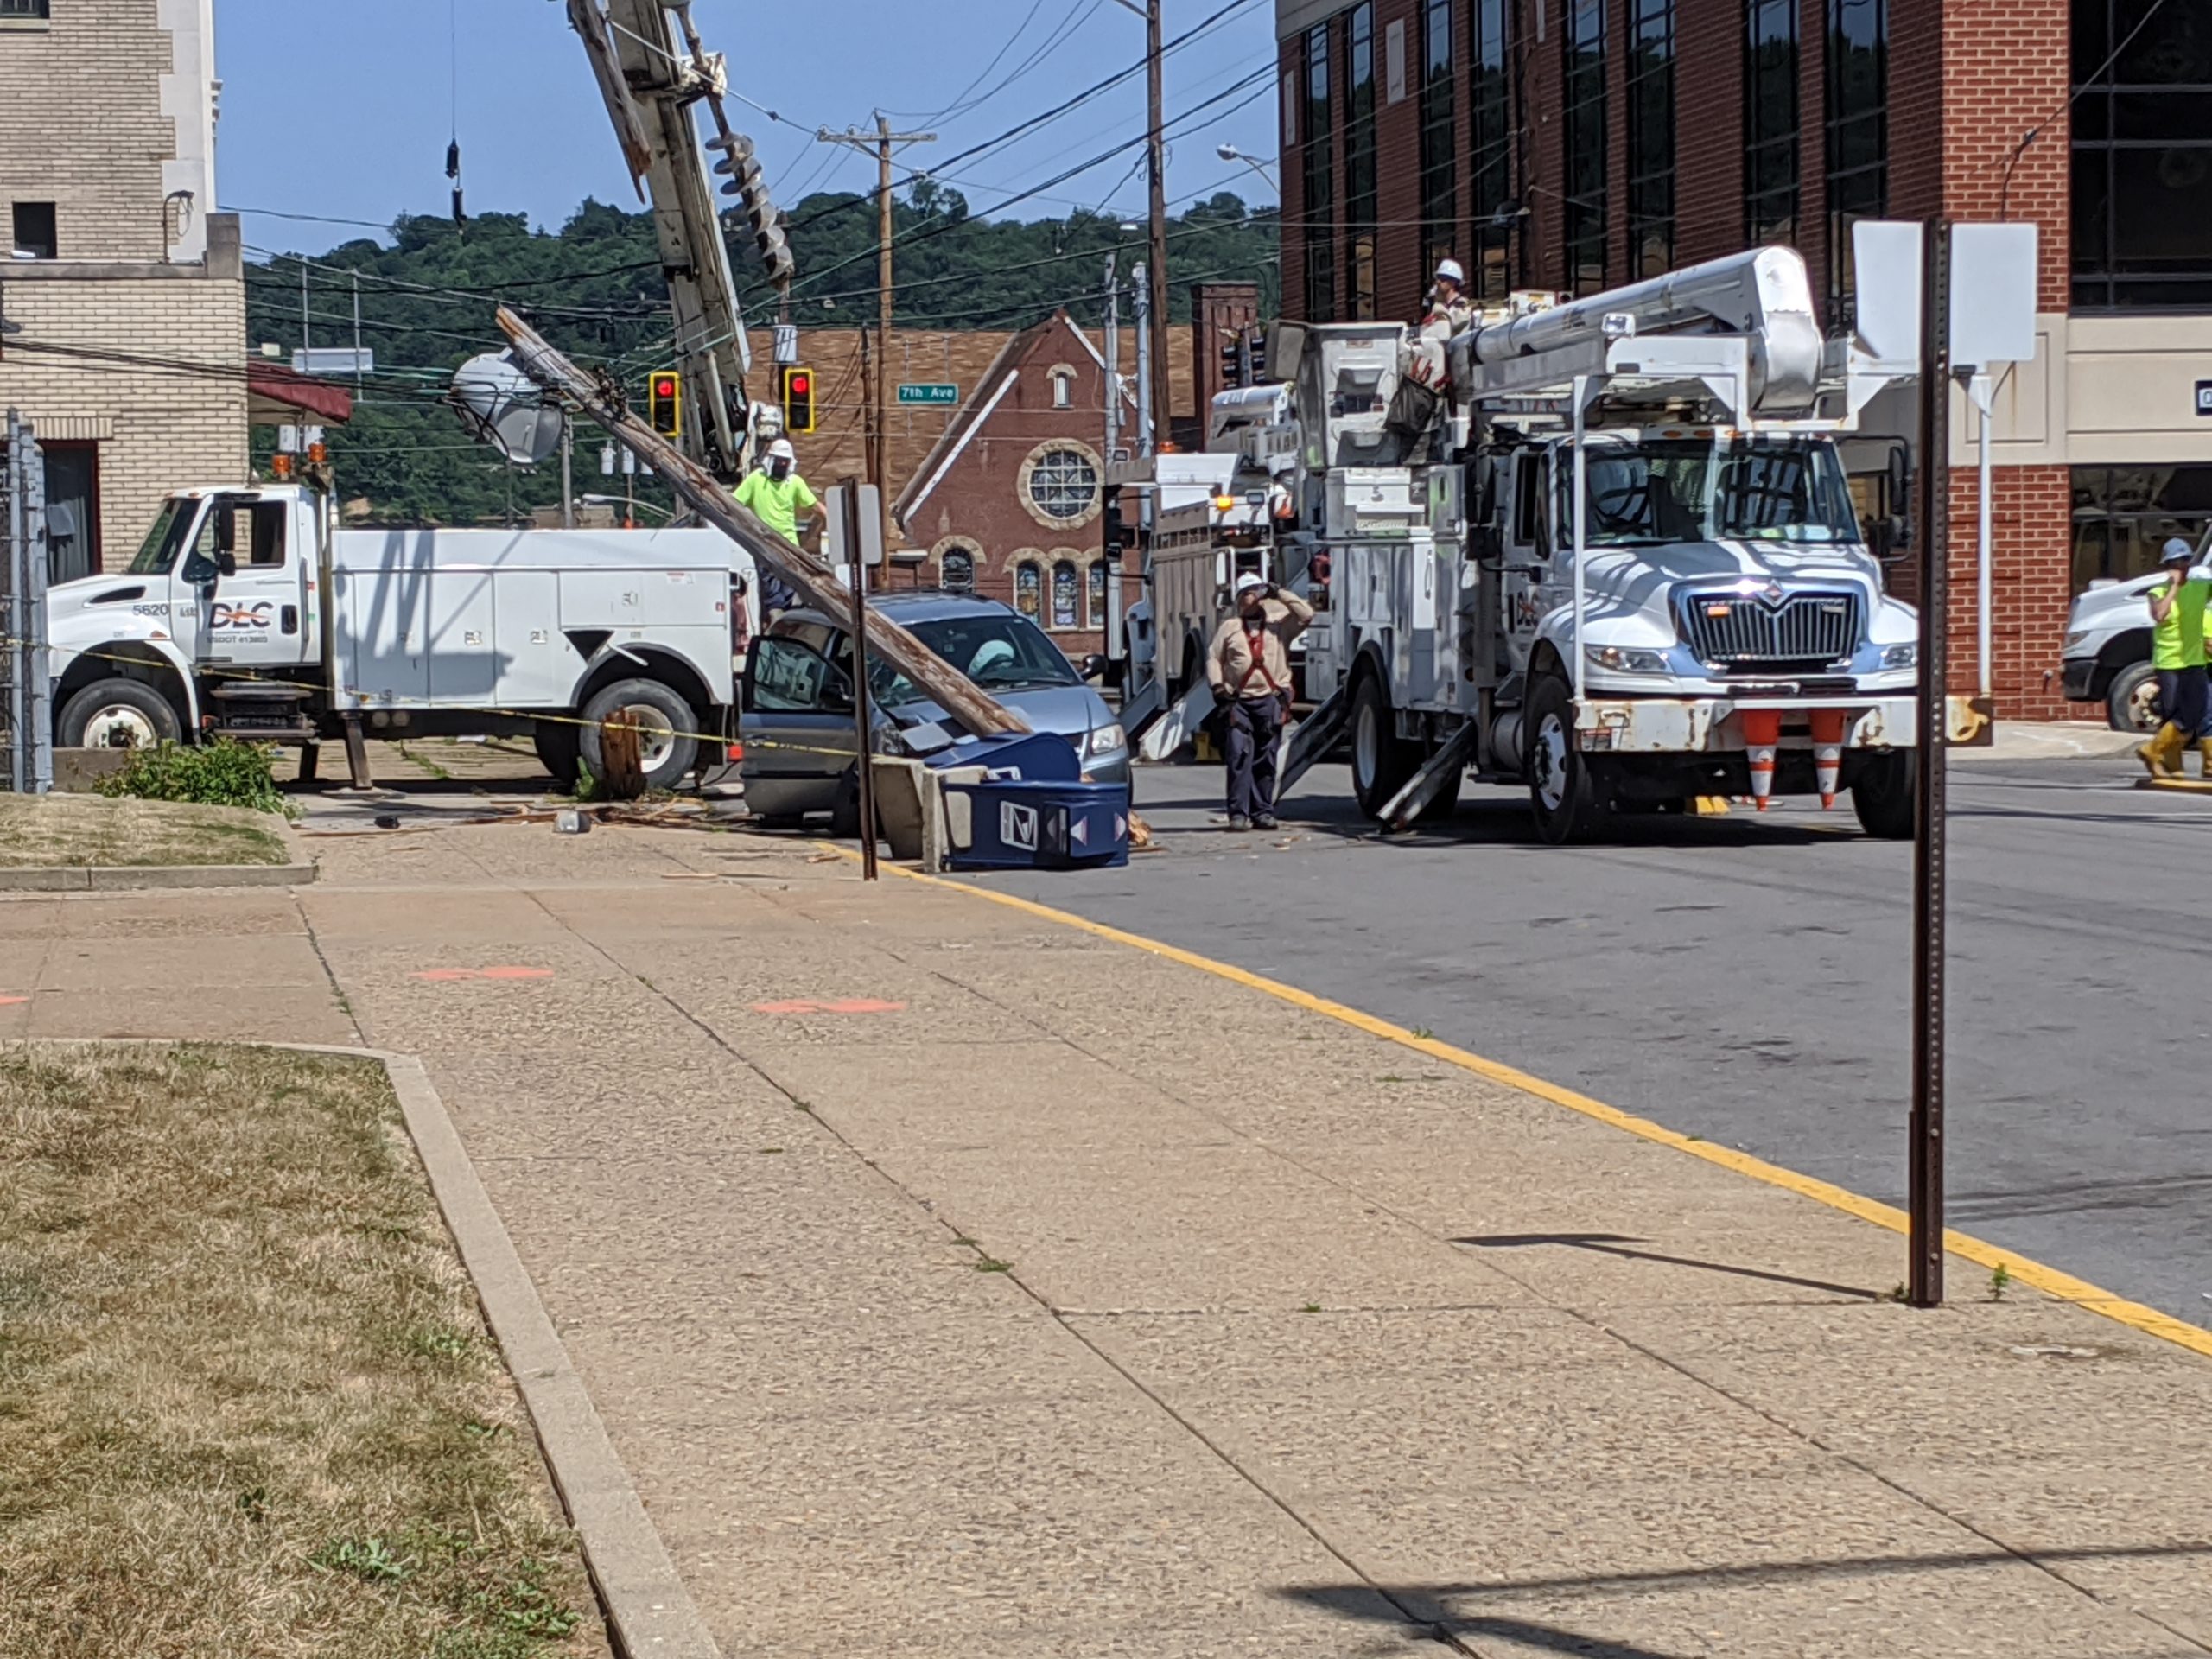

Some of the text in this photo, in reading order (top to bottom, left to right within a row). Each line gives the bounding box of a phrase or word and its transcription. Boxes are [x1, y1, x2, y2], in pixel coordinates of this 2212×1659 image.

[901, 387, 953, 397] 7th Ave
[132, 604, 169, 616] 5620
[208, 601, 274, 629] DLC
